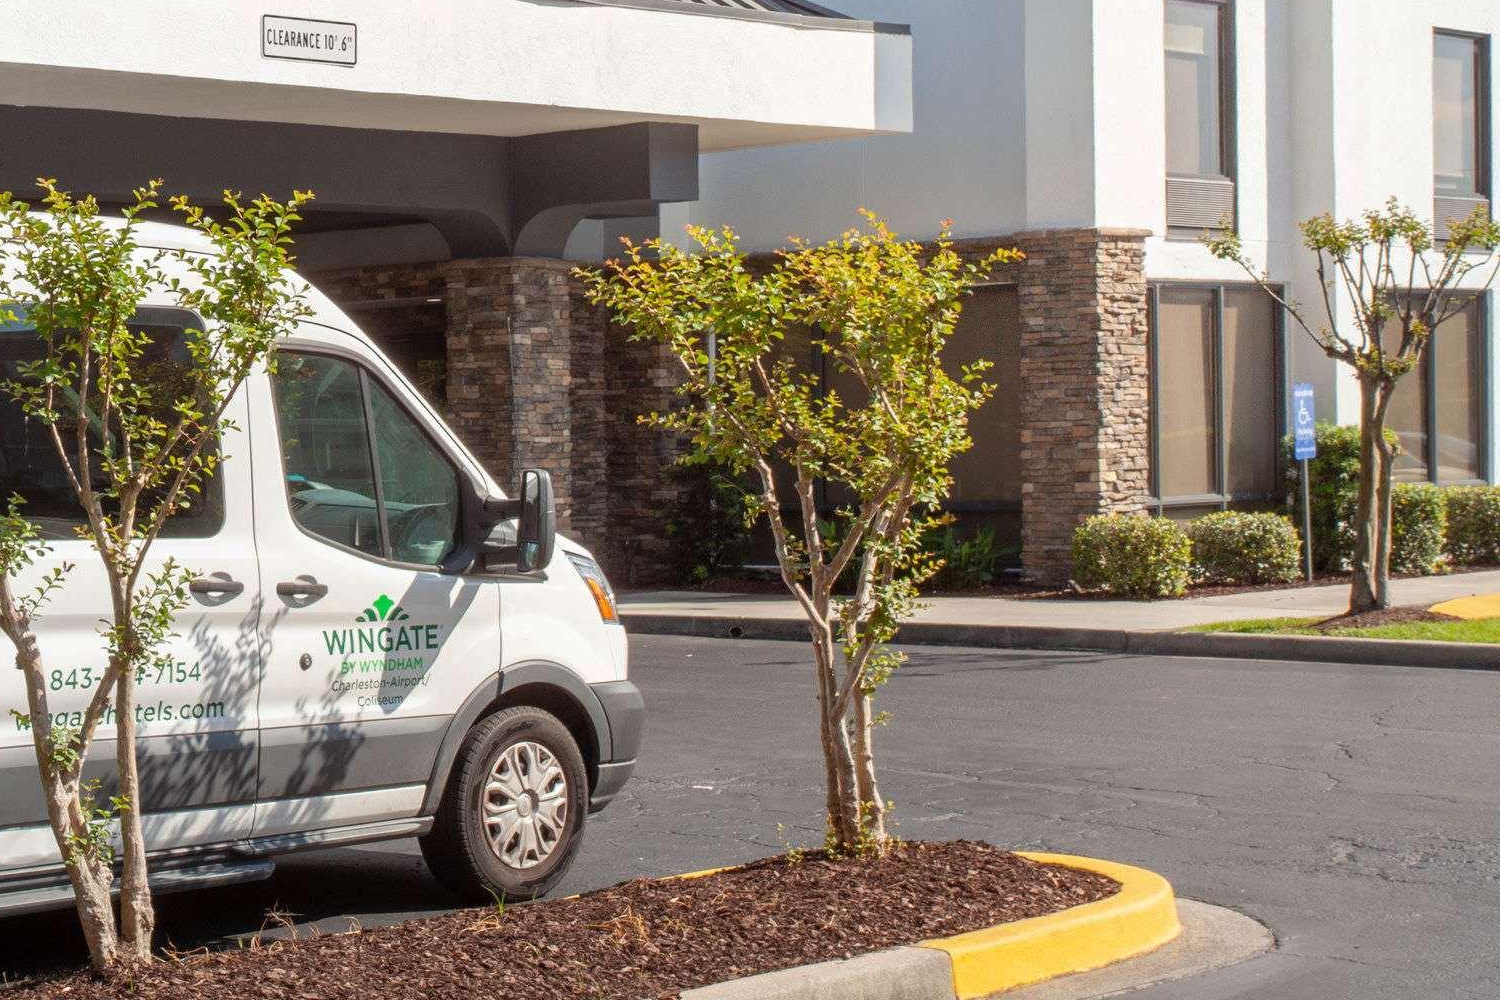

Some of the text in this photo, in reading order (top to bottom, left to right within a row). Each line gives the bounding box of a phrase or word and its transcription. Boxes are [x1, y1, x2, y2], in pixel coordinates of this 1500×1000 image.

[266, 28, 321, 50] CLEARANCE
[322, 623, 439, 656] WINGATE
[50, 660, 202, 692] 843-4-7154
[340, 656, 424, 675] BY WYNDHAM
[331, 673, 431, 693] Charleston-Airport/
[357, 694, 404, 708] Coliseum
